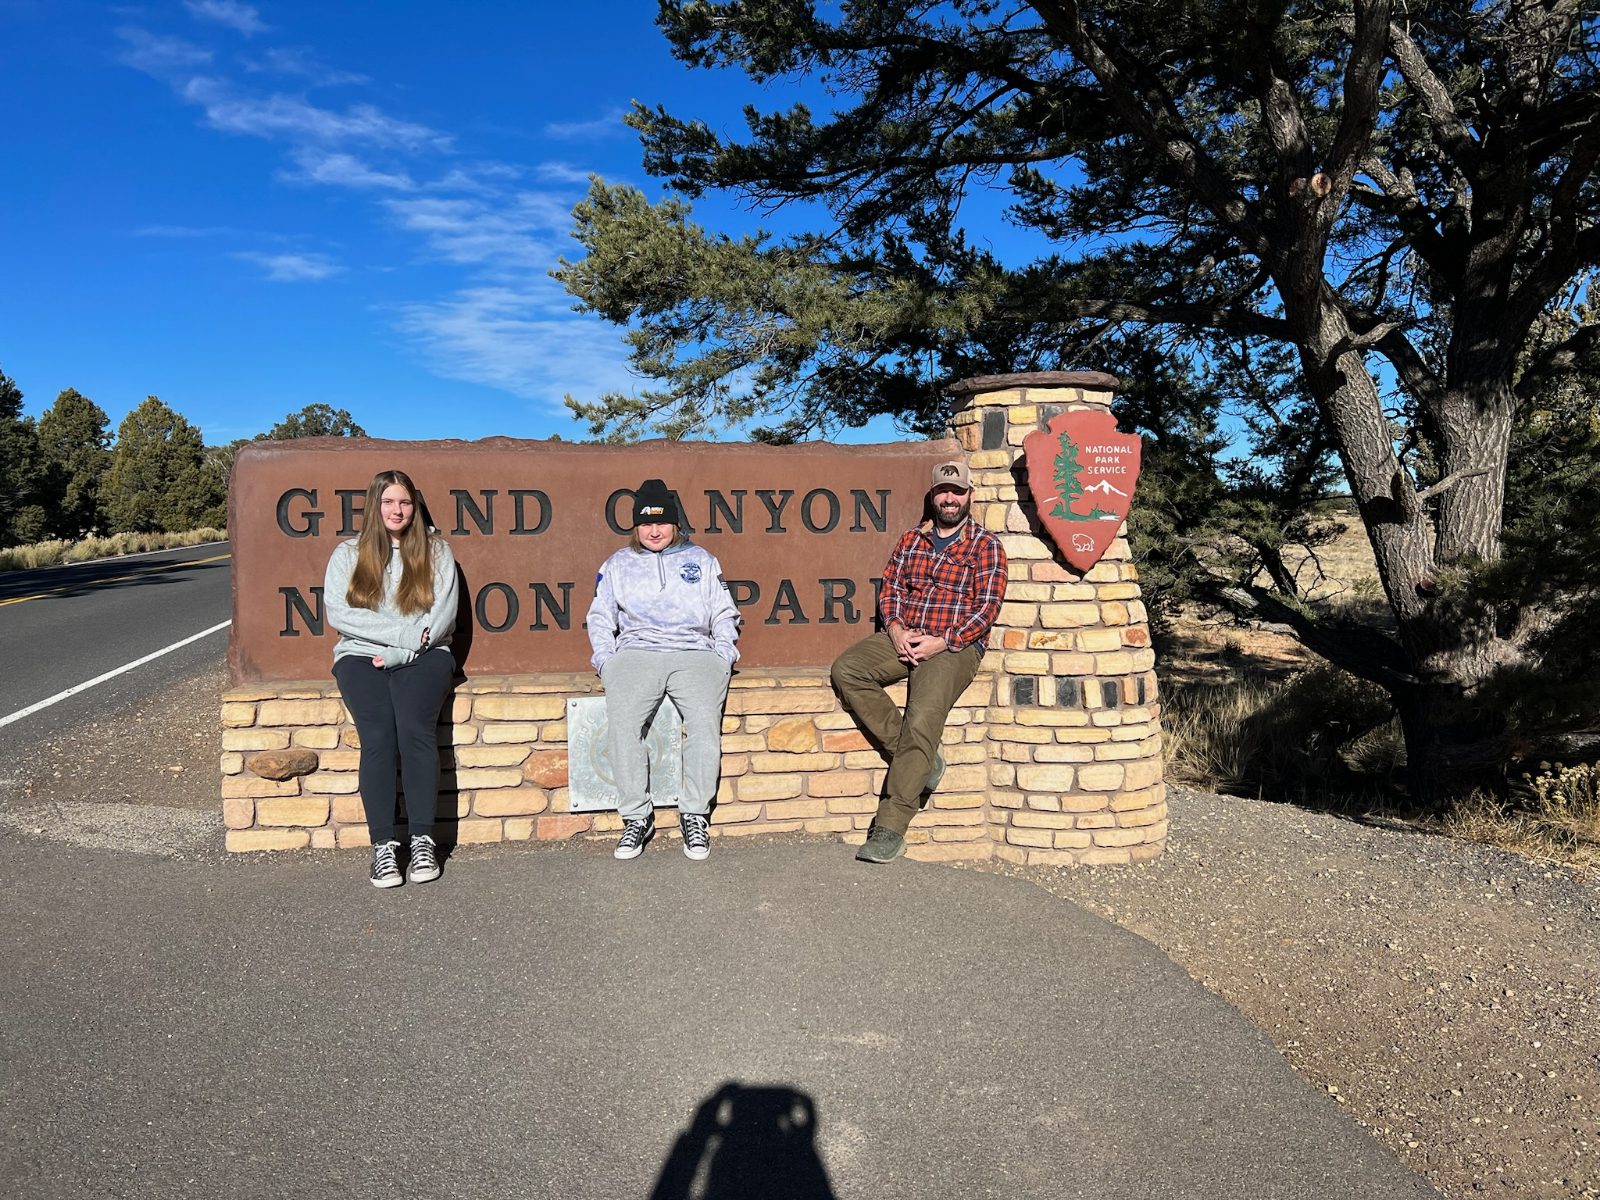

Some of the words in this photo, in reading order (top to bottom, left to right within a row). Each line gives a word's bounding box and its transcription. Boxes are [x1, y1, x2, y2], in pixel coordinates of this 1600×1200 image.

[1085, 445, 1133, 454] NATIONAL
[1095, 456, 1120, 464] PARK
[1087, 466, 1127, 475] SERVICE
